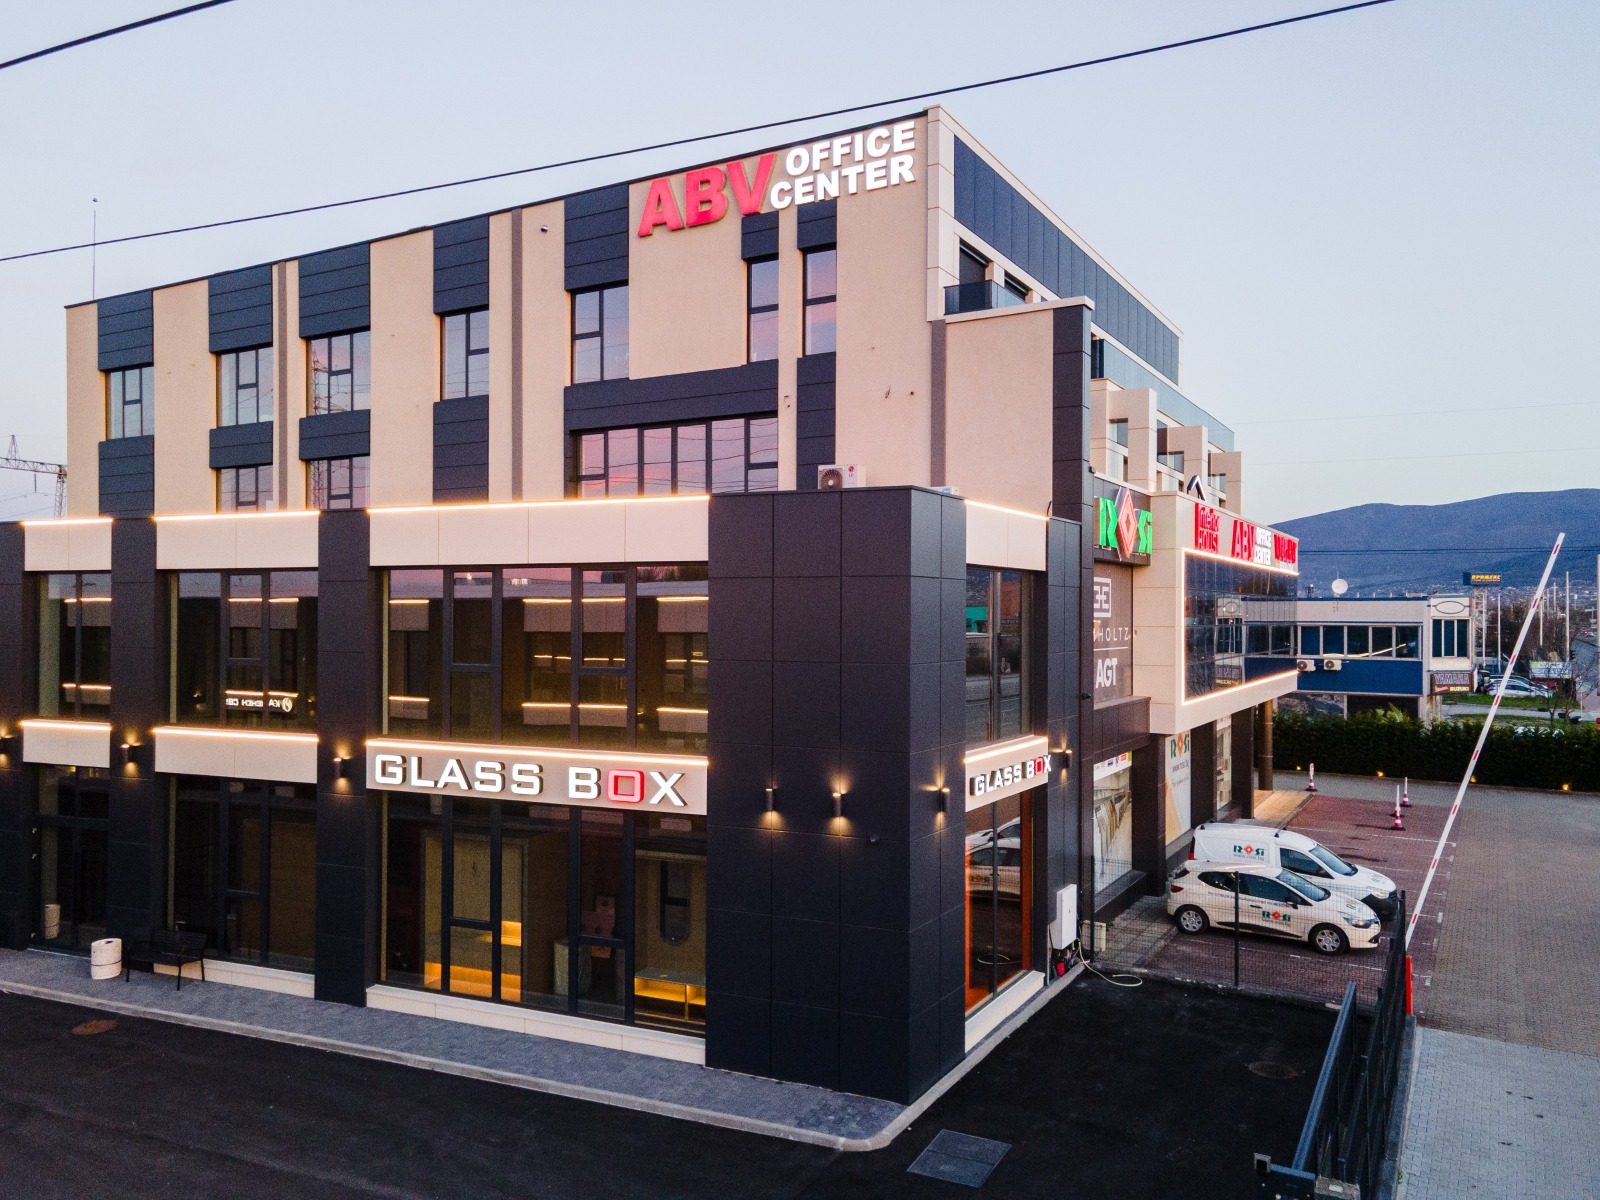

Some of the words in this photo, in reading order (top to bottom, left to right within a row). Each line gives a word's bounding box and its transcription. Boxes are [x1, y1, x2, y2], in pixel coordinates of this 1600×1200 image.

[785, 121, 916, 176] OFFICE
[637, 153, 776, 237] ABV
[769, 154, 917, 210] CENTER
[1231, 519, 1256, 563] ABV
[1095, 658, 1118, 689] AGT
[1433, 673, 1470, 684] YAMAHA
[375, 753, 544, 796] GLASS
[568, 766, 688, 807] BOX
[972, 764, 1022, 796] GLASS
[1024, 755, 1052, 779] BOX
